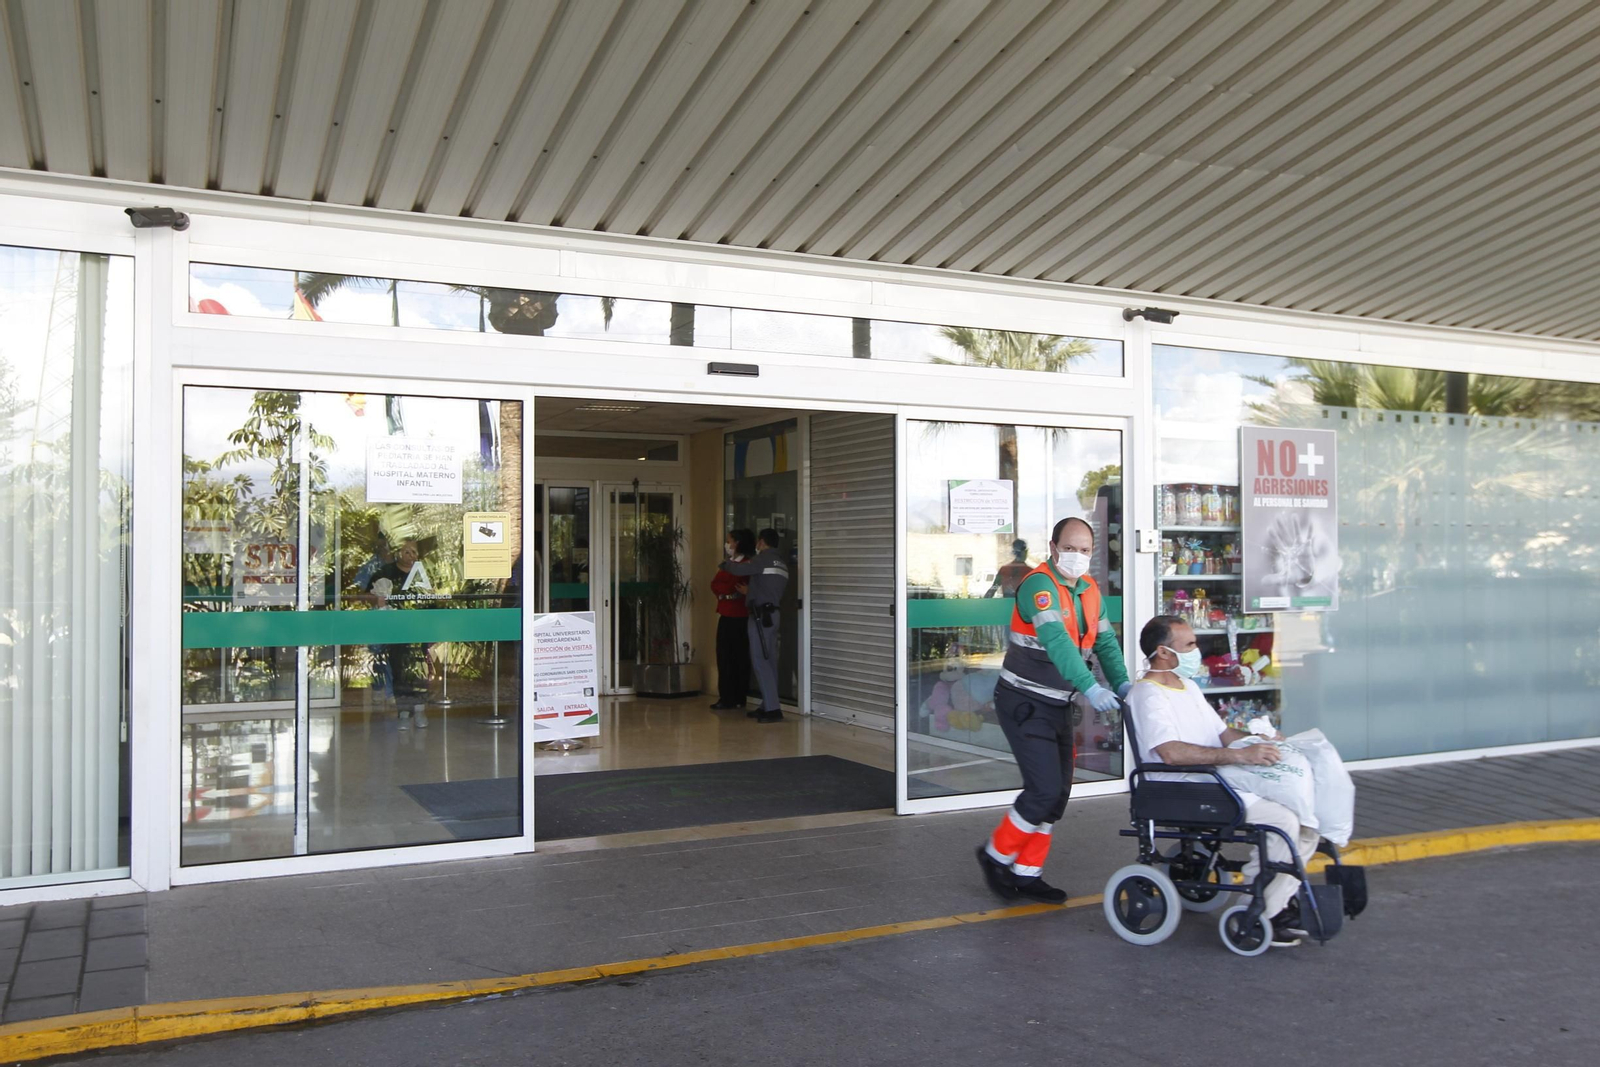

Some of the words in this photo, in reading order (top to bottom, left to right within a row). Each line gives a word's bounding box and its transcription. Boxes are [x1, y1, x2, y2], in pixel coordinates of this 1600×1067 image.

[423, 453, 433, 461] SE
[435, 453, 453, 461] HAN
[381, 461, 437, 470] TRASLADADO
[373, 470, 414, 478] HOSPITAL
[416, 471, 456, 479] MATERNO
[1254, 478, 1328, 495] AGRESIONES
[1253, 498, 1262, 507] AL
[1262, 498, 1293, 507] PERSONAL
[1294, 499, 1302, 508] DE
[1302, 499, 1329, 508] SANIDAD
[245, 544, 317, 569] STO
[534, 645, 564, 654] STRICCIÓN
